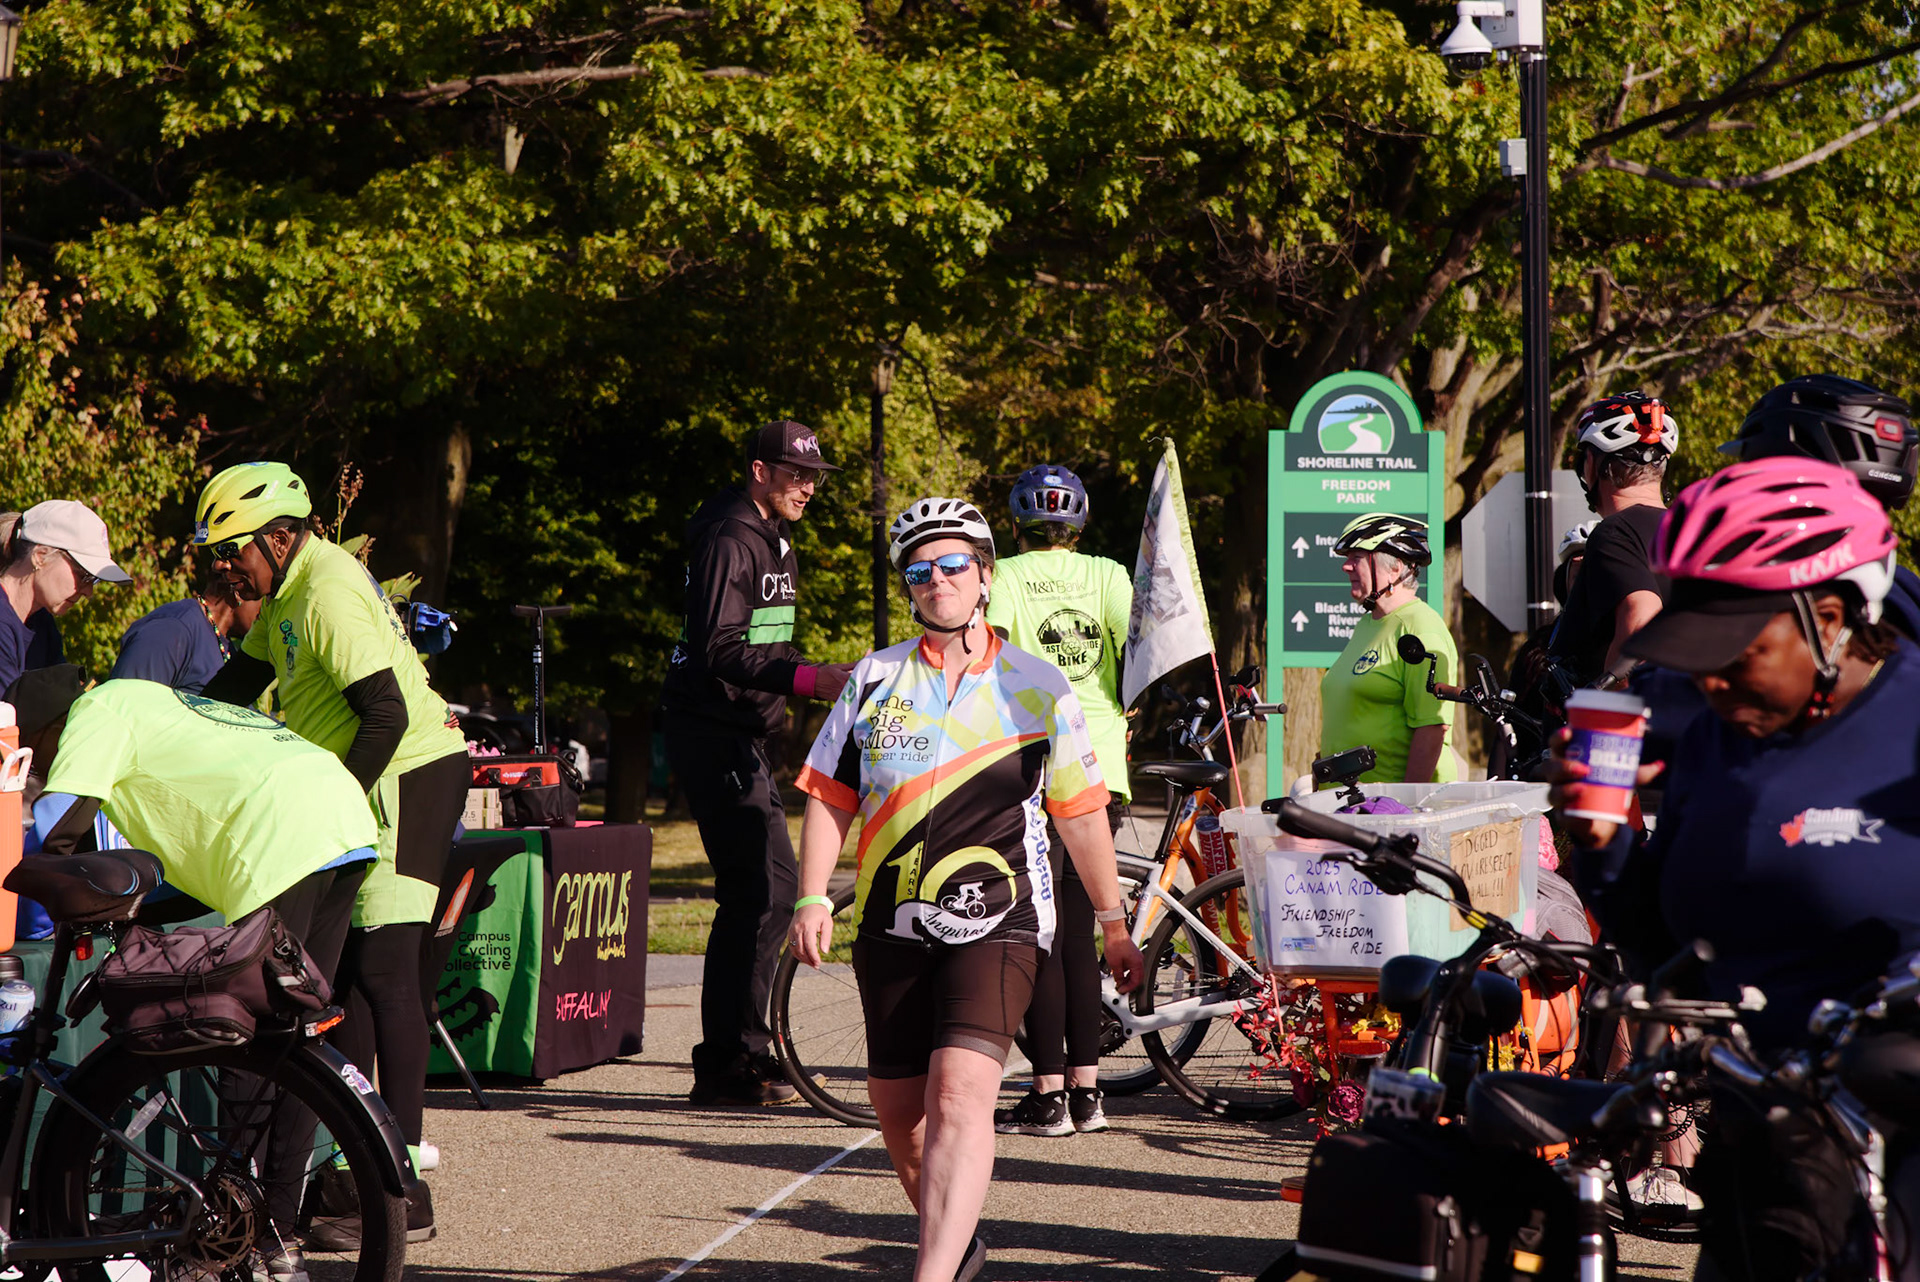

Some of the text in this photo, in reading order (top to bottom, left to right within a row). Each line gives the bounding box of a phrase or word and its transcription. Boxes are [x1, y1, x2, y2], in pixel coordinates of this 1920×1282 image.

[1297, 456, 1417, 469] SHORELINE TRAIL
[1321, 479, 1391, 491] FREEDOM
[1336, 492, 1376, 504] PARK
[1026, 579, 1086, 595] M&T Bank
[1315, 602, 1367, 614] Black Ro
[1042, 640, 1099, 653] EAST SIDE
[1057, 651, 1087, 667] BIKE
[864, 729, 929, 751] Move
[462, 810, 476, 819] 7.5
[1210, 830, 1228, 876] BUFFA
[908, 846, 923, 896] YEARS
[1306, 859, 1341, 876] 2025
[1284, 873, 1342, 895] CANAM
[1281, 903, 1356, 926] FRIENDSHIP
[458, 932, 511, 945] Campus
[1316, 925, 1374, 938] FREEDOM
[458, 944, 512, 960] Cycling
[1350, 941, 1384, 955] RIDE
[444, 957, 512, 972] ollective
[556, 991, 599, 1022] BUFFAL
